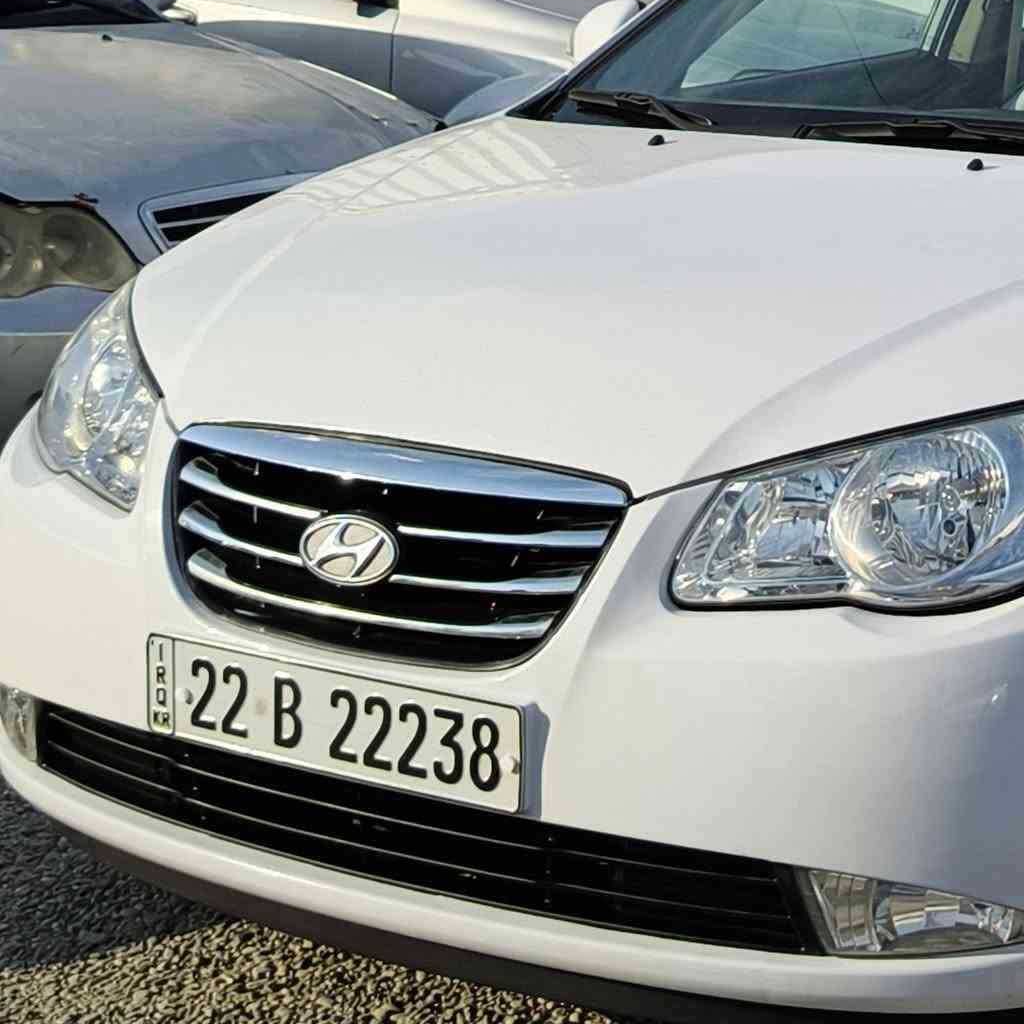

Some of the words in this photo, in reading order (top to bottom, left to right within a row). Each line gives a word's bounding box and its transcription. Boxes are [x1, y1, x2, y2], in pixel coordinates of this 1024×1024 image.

[190, 658, 249, 739] 22
[273, 675, 303, 749] B
[328, 687, 501, 793] 22238
